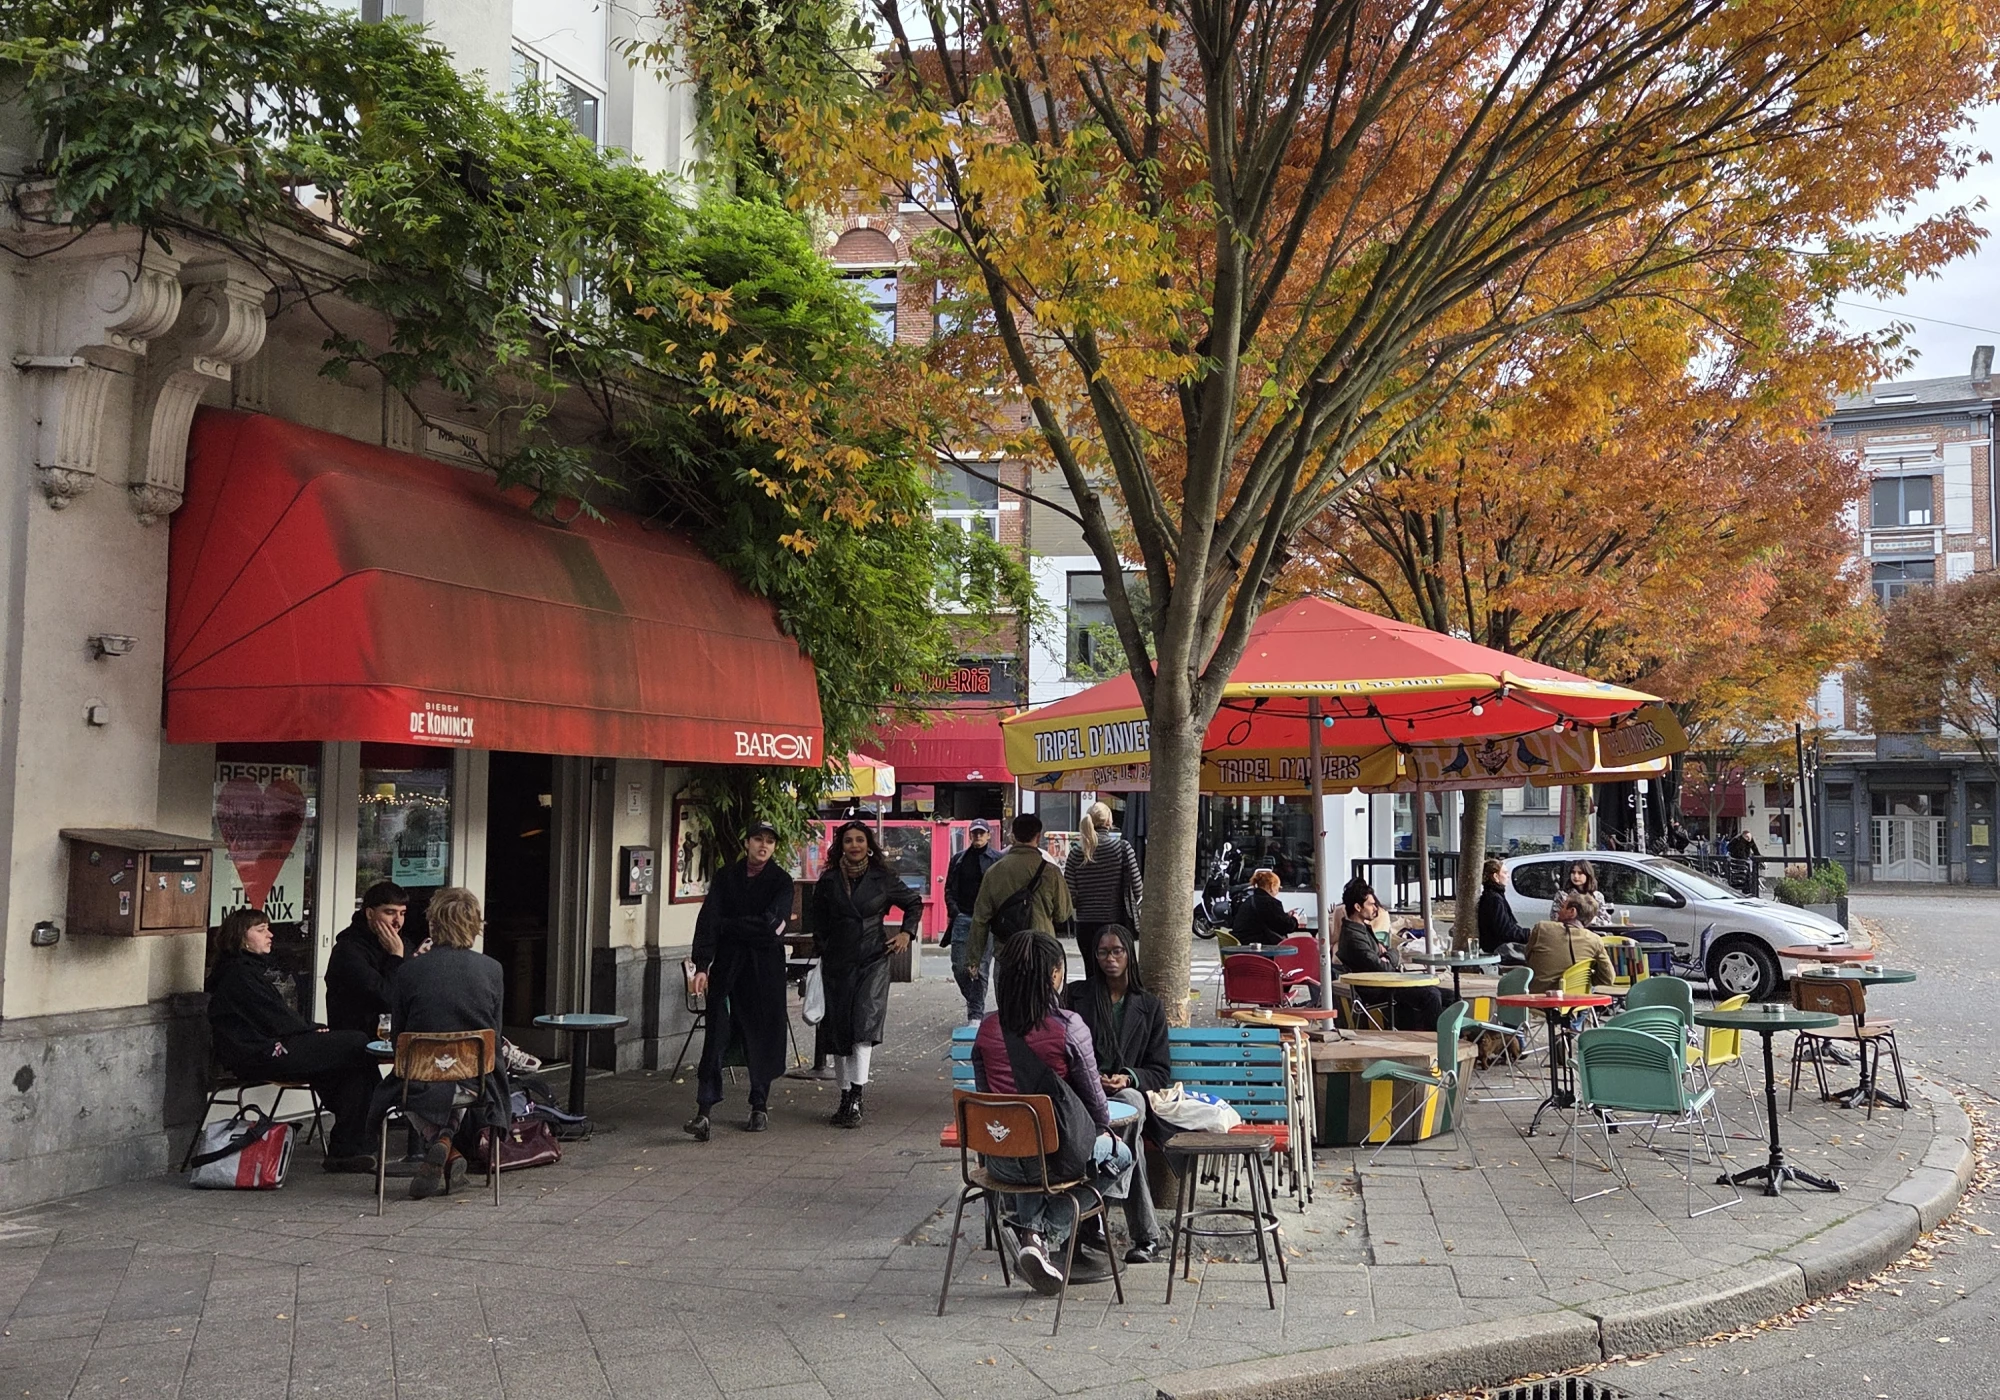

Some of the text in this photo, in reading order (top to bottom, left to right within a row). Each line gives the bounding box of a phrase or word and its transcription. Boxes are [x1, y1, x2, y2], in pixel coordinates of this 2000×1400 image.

[425, 702, 459, 713] BIEREN
[409, 711, 474, 738] DE KONINCK
[734, 731, 813, 760] BARON
[1034, 719, 1151, 763] TRIPEL D'ANVER
[220, 764, 306, 784] RESPECT
[1218, 758, 1273, 784] TRIPEL
